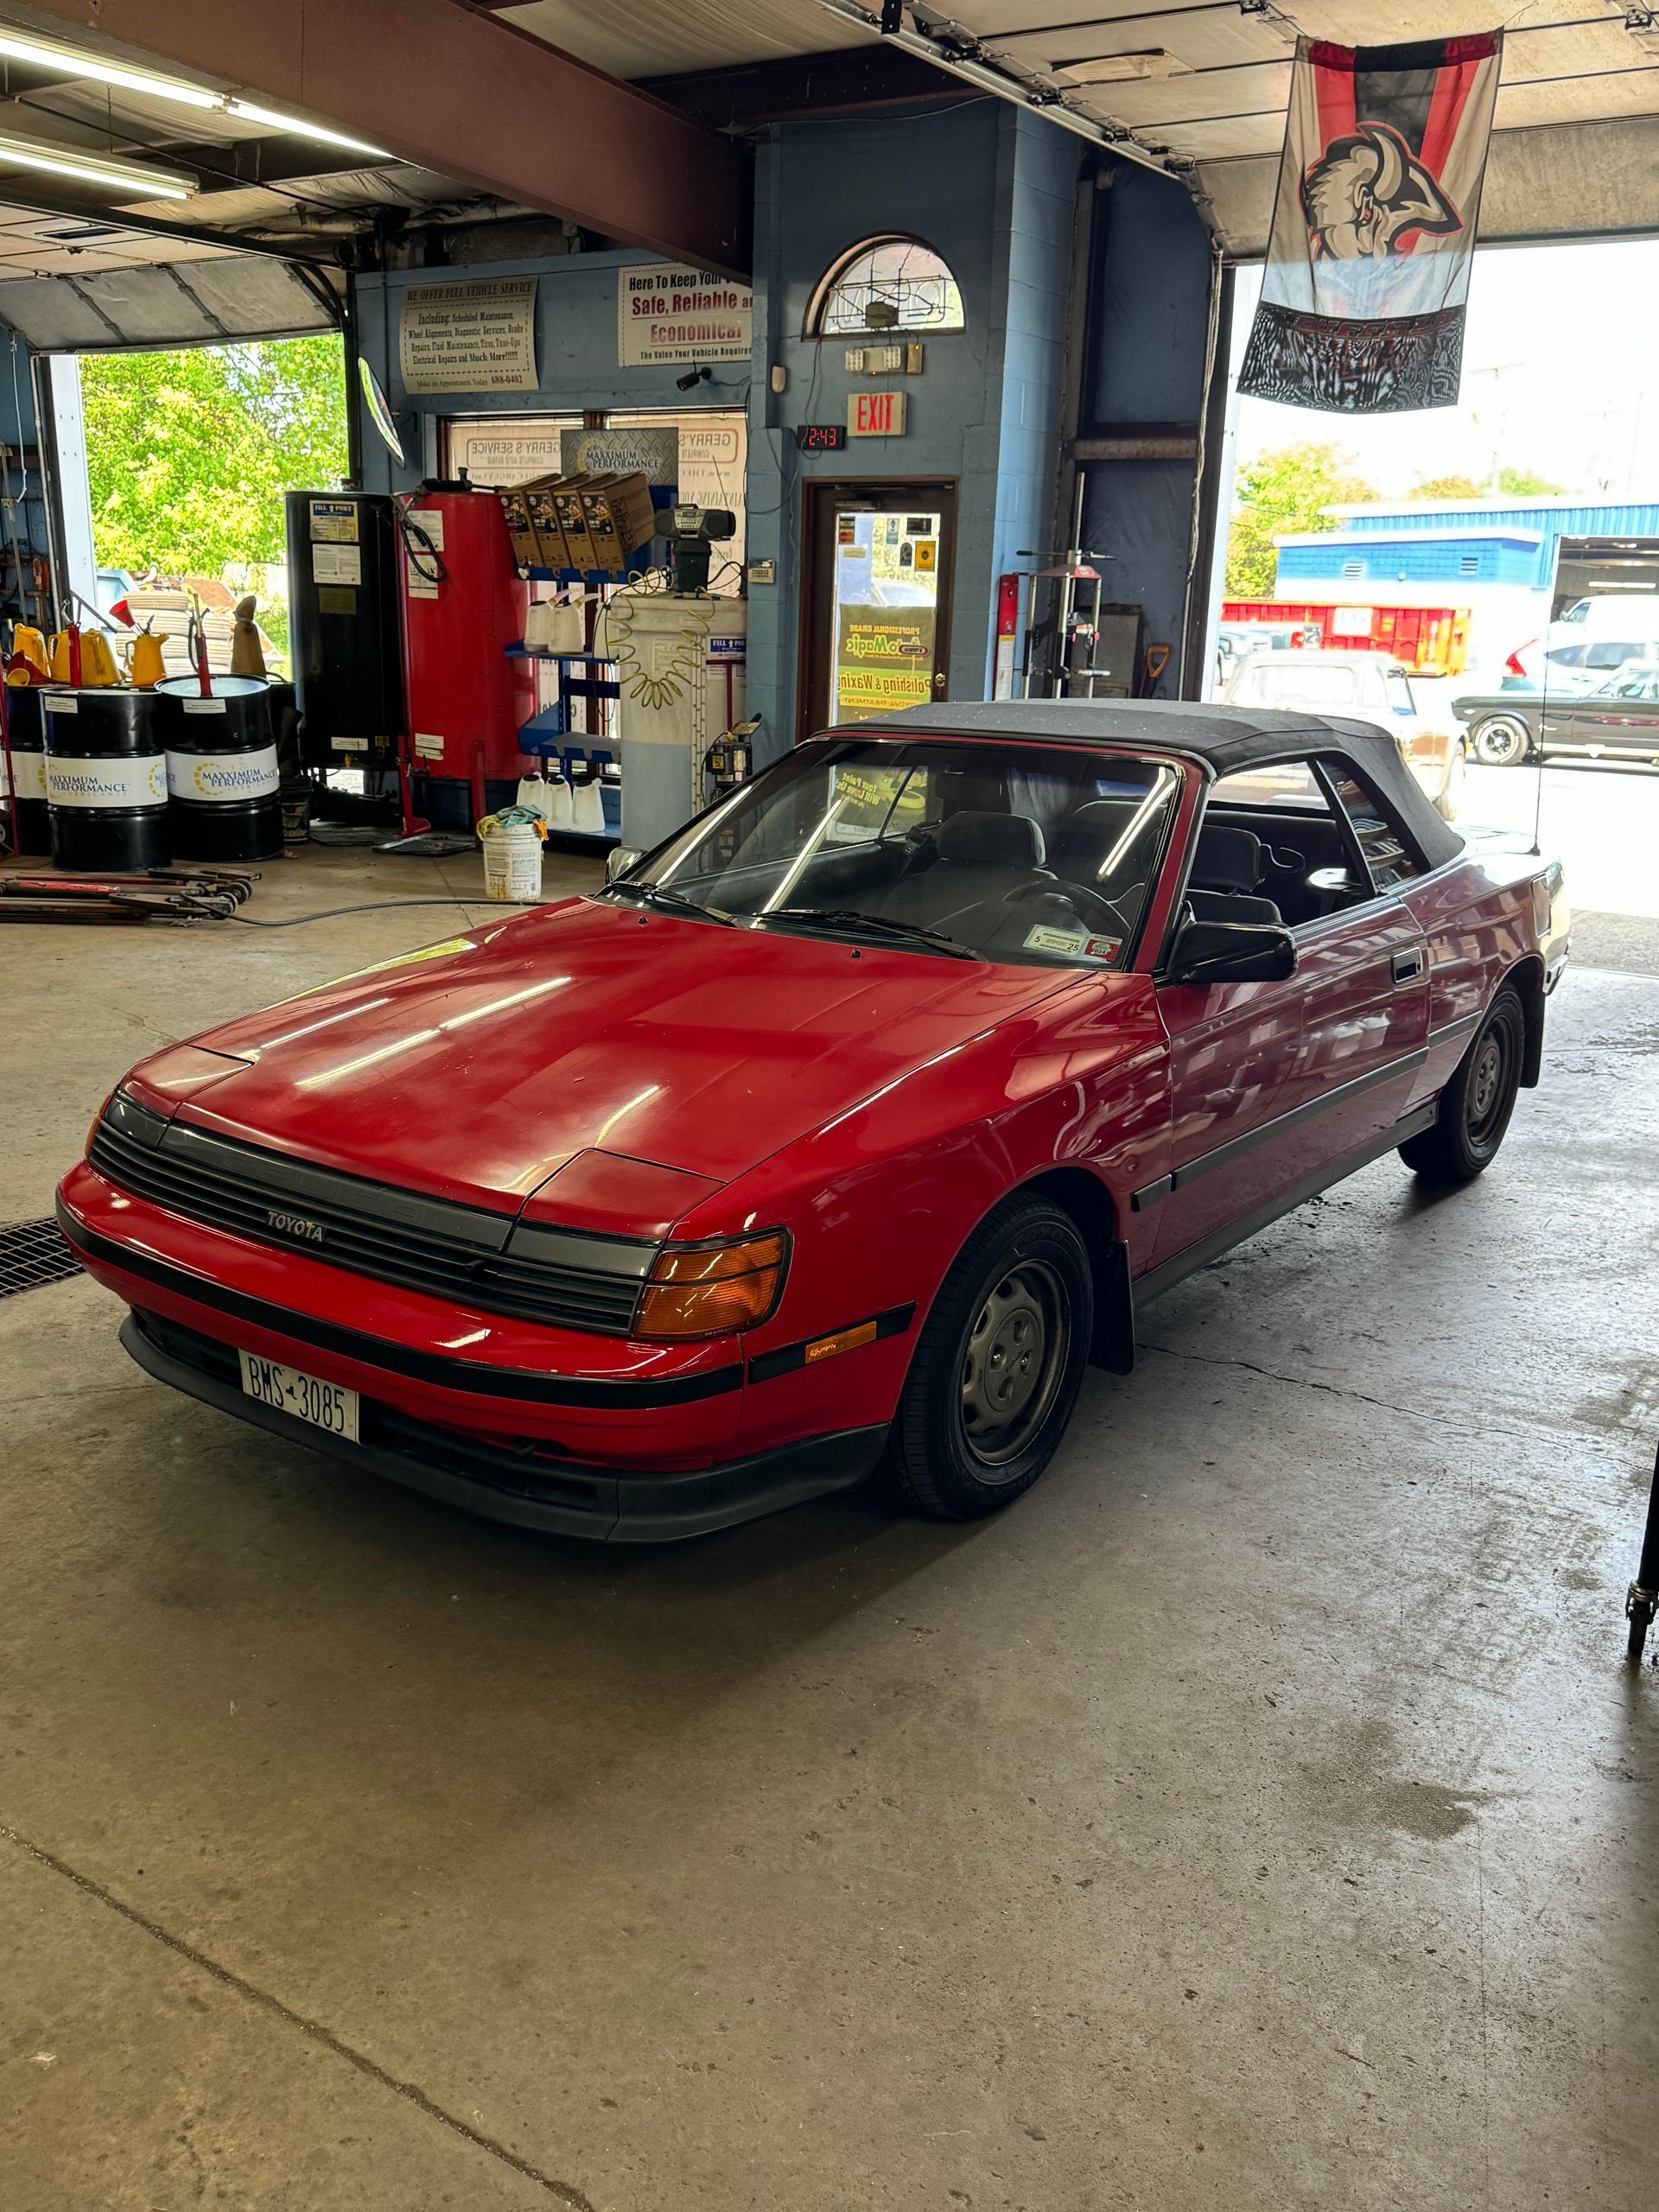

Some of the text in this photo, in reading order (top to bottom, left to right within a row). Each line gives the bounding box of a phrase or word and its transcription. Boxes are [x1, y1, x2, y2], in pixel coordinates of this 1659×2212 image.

[629, 276, 653, 290] Here
[656, 275, 668, 289] To
[670, 274, 696, 288] Keep
[407, 281, 532, 301] WE OFFER FULL VEHICLE SERVICE
[632, 296, 670, 315] Safe,
[672, 290, 737, 313] Reliable
[418, 310, 514, 325] Including: Scheduled Maintenance,
[408, 324, 524, 341] Wheel Alignments, Diagnostic Services, Brake
[650, 319, 741, 343] Economical
[411, 343, 431, 353] Repairs,
[432, 341, 444, 351] Fluid
[447, 340, 480, 352] Maintenance,
[480, 339, 495, 349] Tires,
[641, 351, 652, 359] The
[654, 350, 672, 359] Value
[675, 348, 690, 358] Your
[692, 347, 718, 357] Vehicle
[413, 355, 435, 365] Electrical
[438, 354, 457, 365] Repairs
[459, 353, 467, 362] and
[469, 352, 487, 362] Much
[440, 378, 471, 388] Appointment
[491, 375, 523, 385] 688-0402
[857, 394, 894, 432] EXIT
[809, 428, 836, 446] 2:43
[586, 451, 636, 461] MAXXIMUM
[593, 459, 659, 468] PERFORMANCE
[49, 774, 98, 785] MAXXIMUM
[202, 769, 261, 780] MAXXIMUM
[211, 767, 277, 787] PERFORMANCE
[53, 783, 127, 792] PERFORMANCE
[1066, 943, 1079, 951] 25
[266, 1211, 323, 1243] TOYOTA
